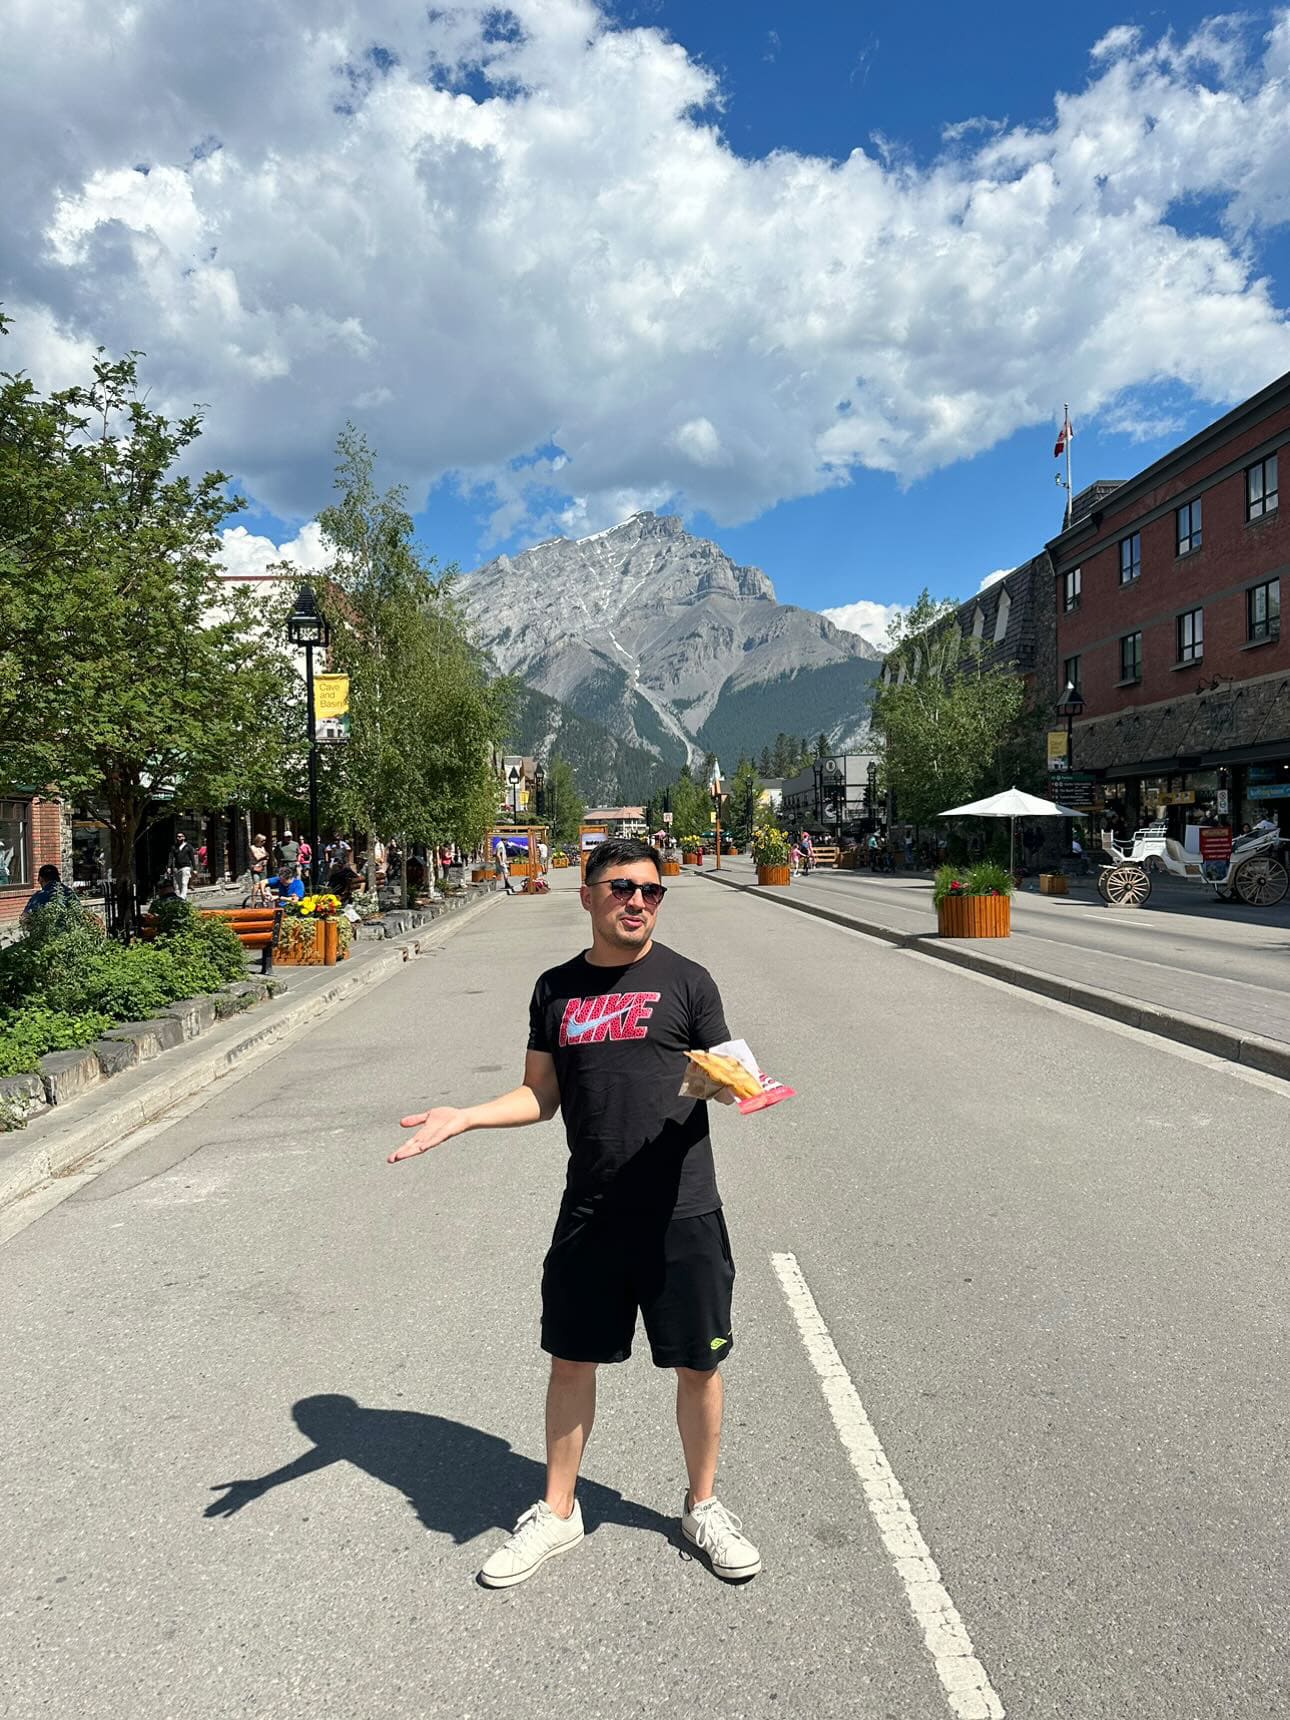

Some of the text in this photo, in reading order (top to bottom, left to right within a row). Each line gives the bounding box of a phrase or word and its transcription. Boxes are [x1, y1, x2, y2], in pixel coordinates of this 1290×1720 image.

[319, 683, 340, 691] Cave
[320, 700, 343, 708] Basin
[559, 991, 661, 1047] NIKE
